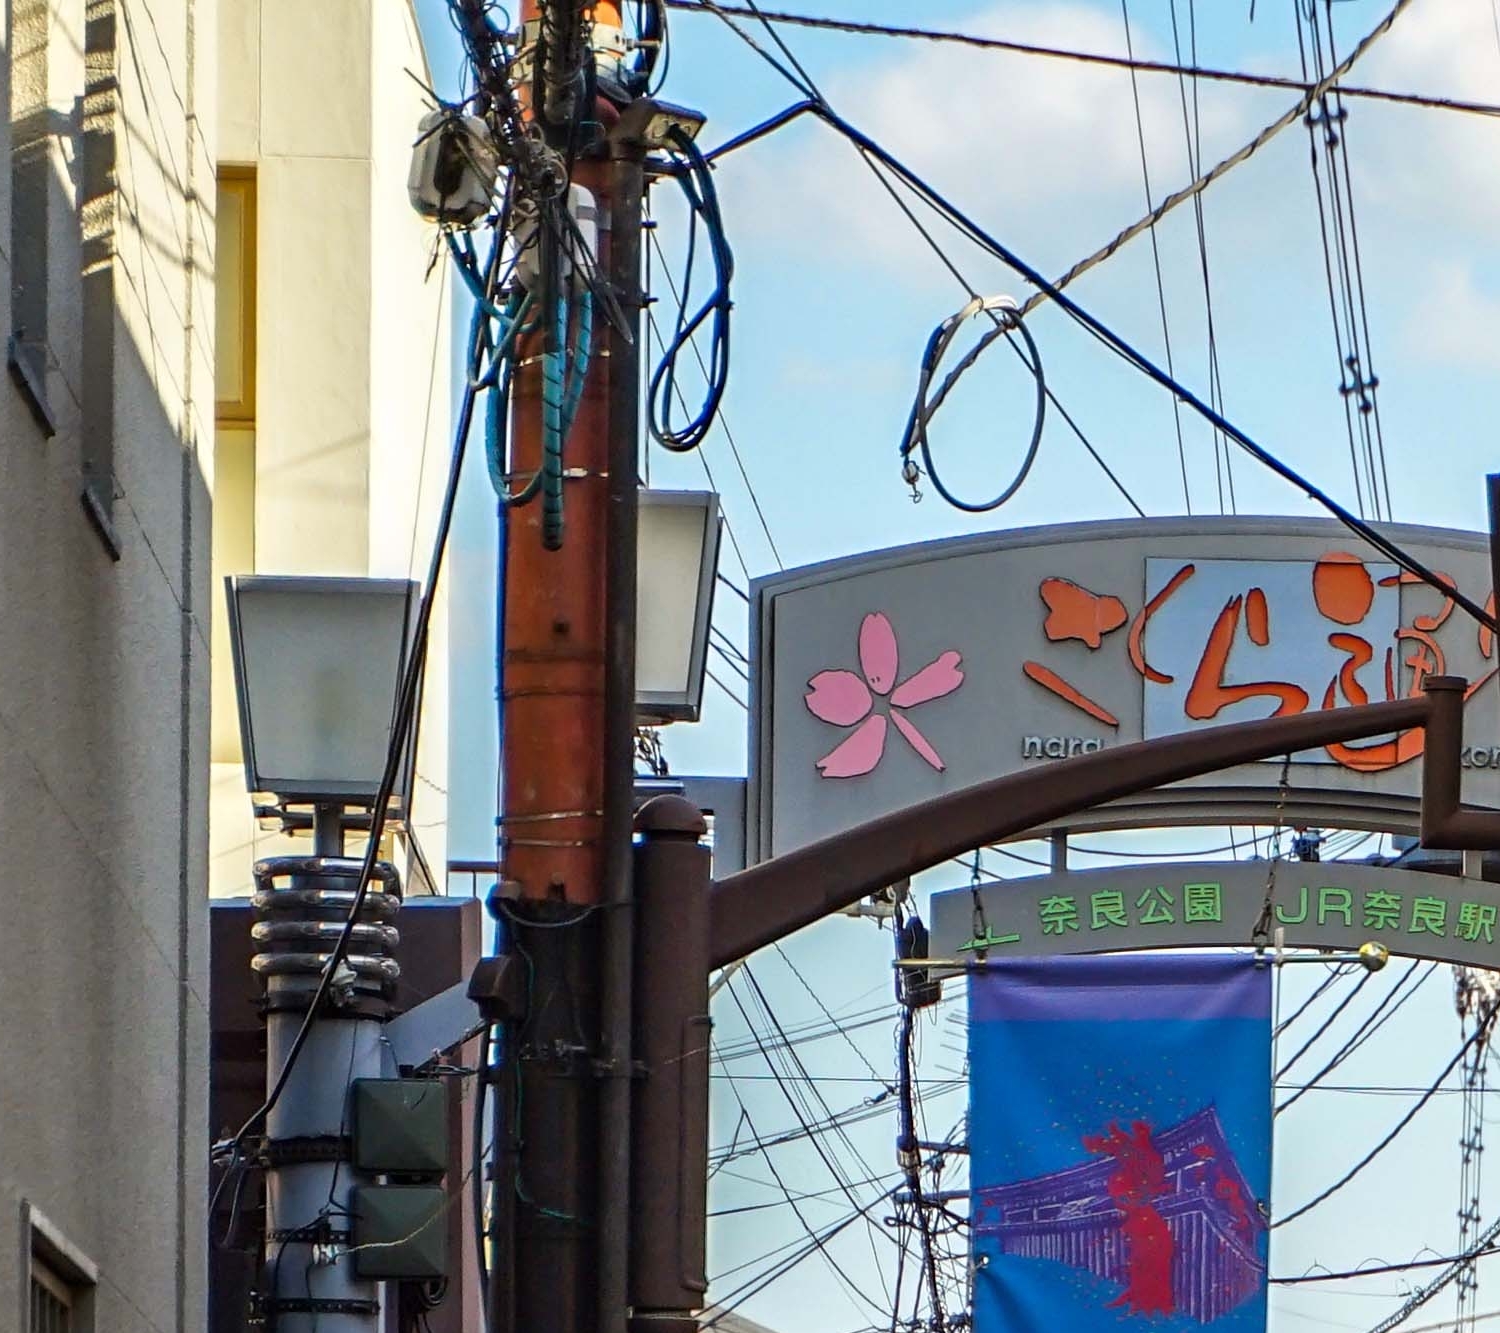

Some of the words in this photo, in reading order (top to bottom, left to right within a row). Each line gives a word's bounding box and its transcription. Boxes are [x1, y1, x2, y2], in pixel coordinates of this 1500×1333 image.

[1039, 882, 1223, 934] 奈良公園
[1277, 888, 1498, 944] JR奈良駅
